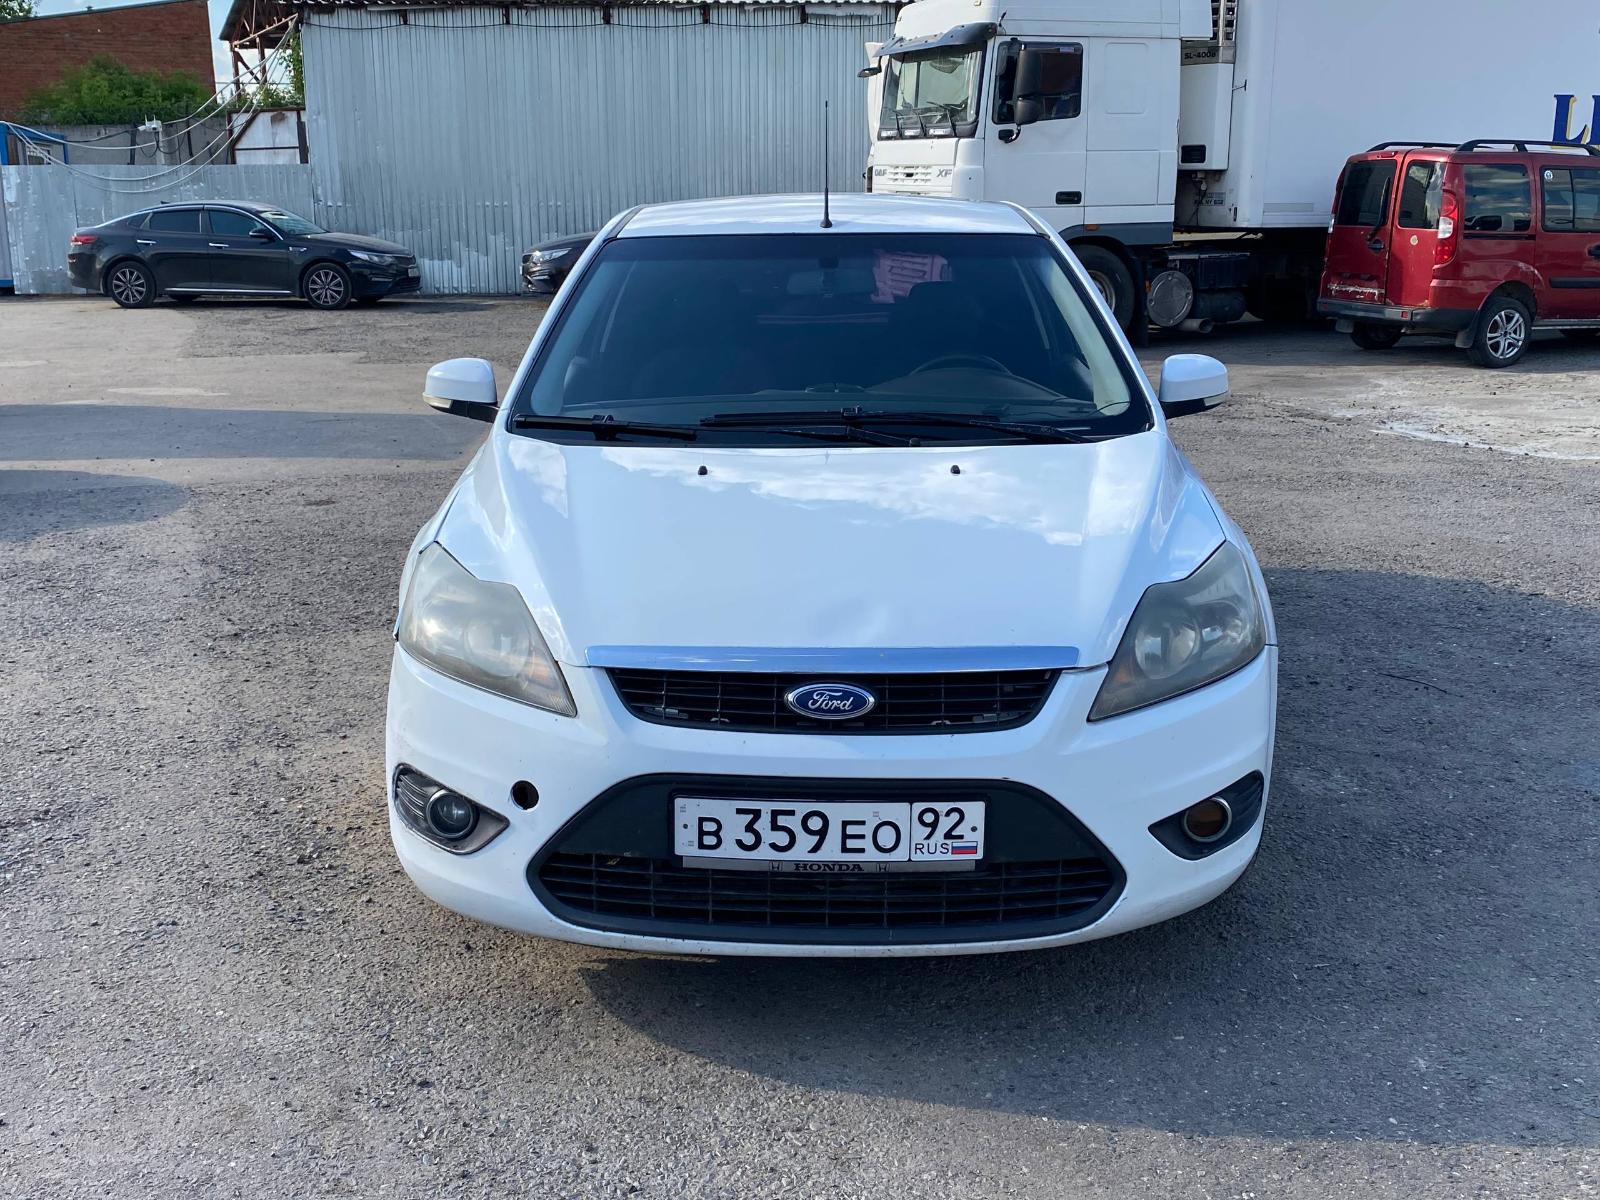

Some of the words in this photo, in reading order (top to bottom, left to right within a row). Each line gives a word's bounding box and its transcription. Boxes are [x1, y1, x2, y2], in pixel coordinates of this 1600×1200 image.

[937, 169, 953, 178] XF
[808, 690, 854, 711] Ford
[917, 807, 966, 841] 92
[914, 842, 950, 855] RUS
[793, 862, 865, 873] HONDA
